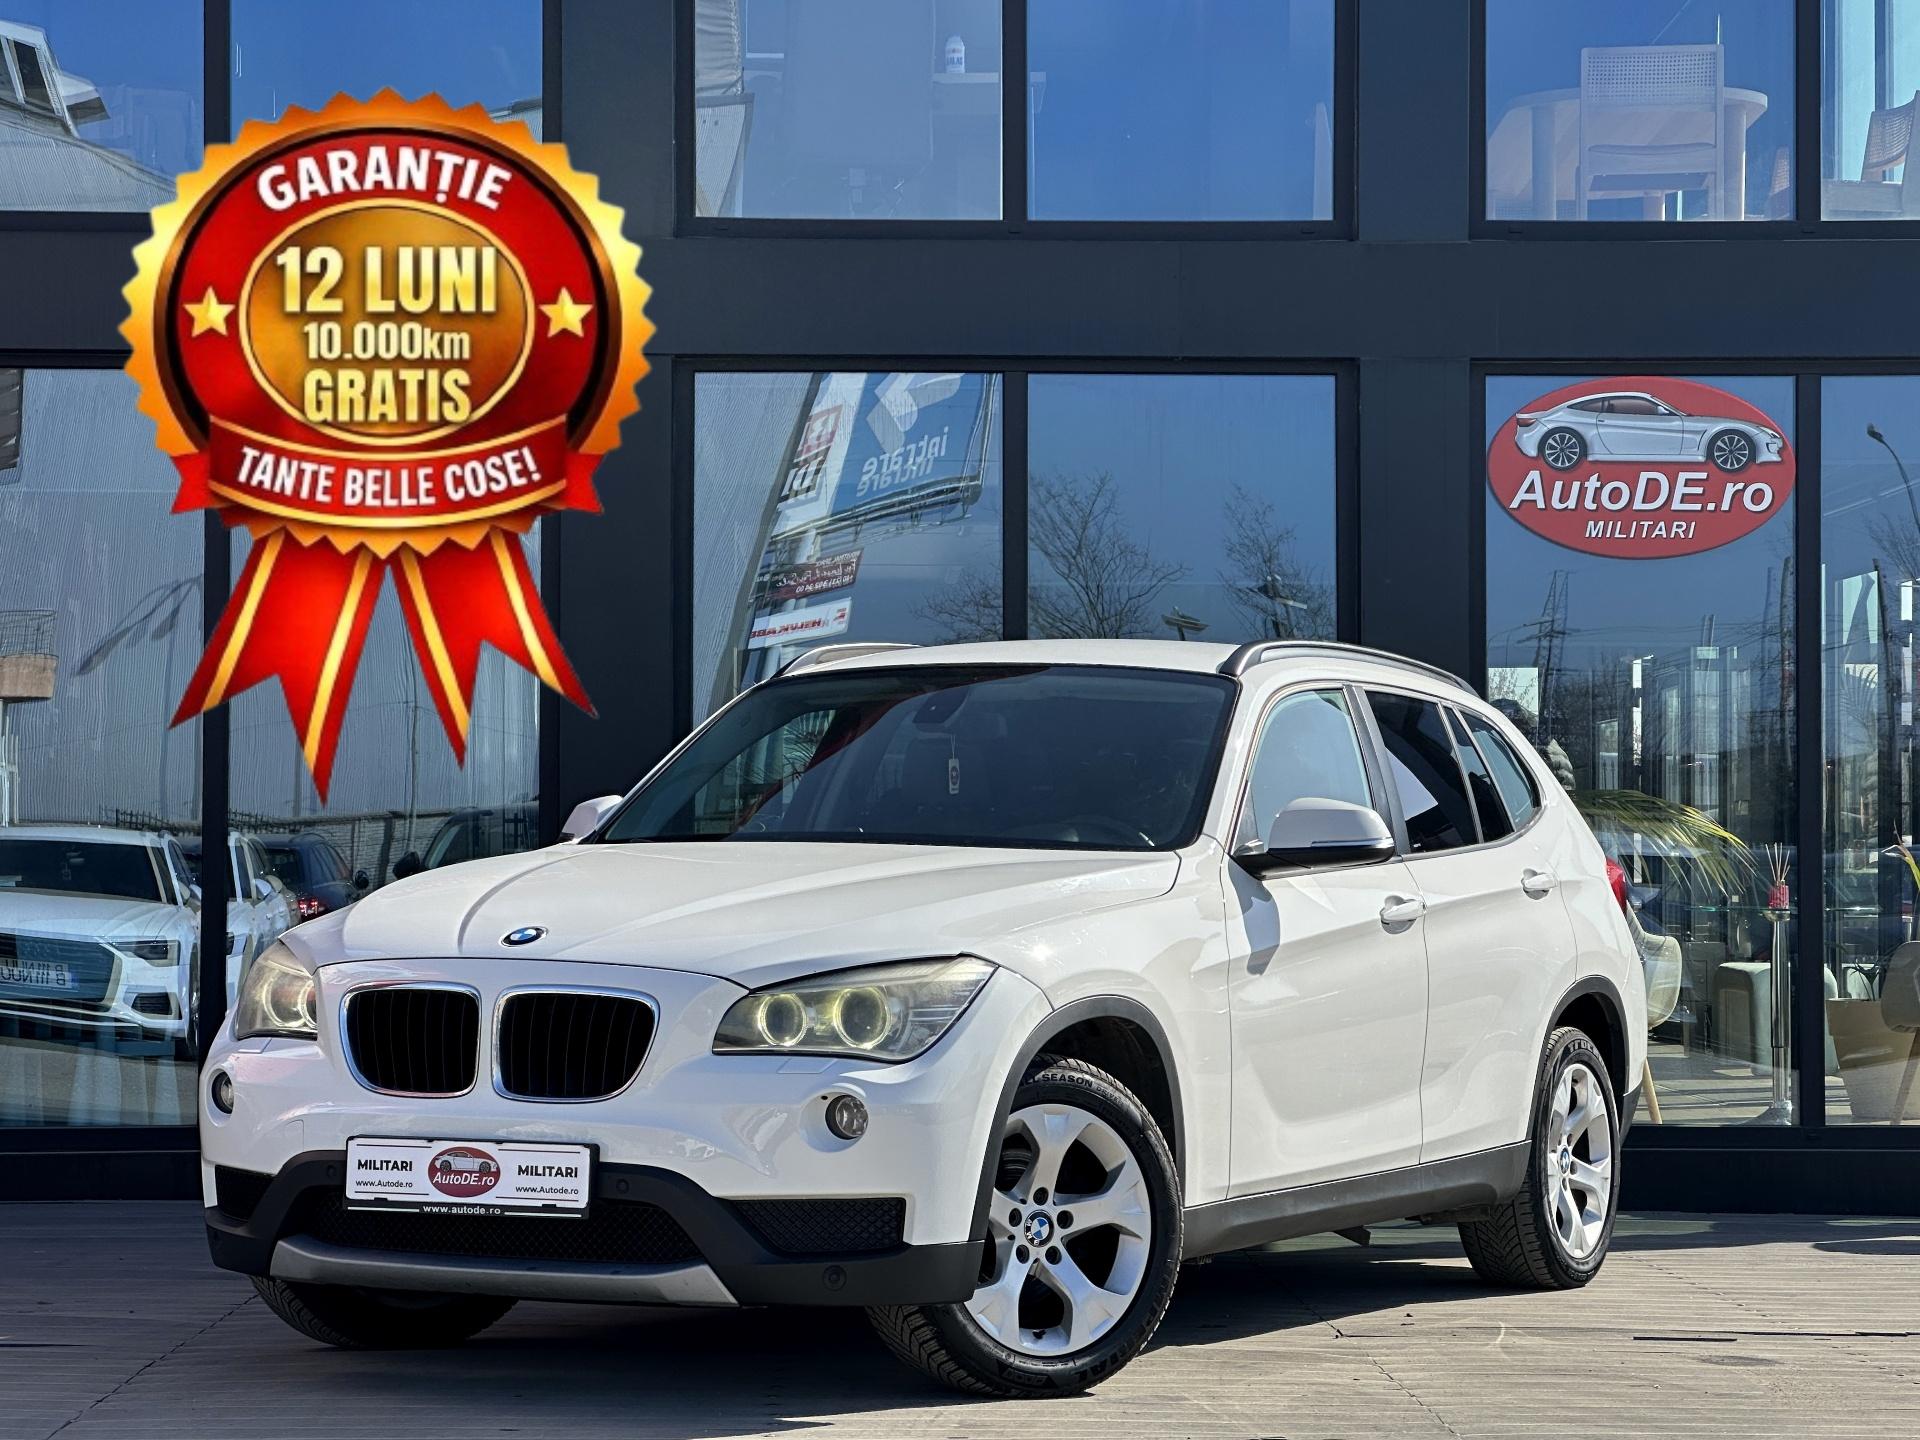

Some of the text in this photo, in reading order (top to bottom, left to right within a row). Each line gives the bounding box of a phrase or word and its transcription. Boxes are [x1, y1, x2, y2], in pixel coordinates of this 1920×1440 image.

[1508, 469, 1773, 512] AutoDE.ro
[1585, 520, 1696, 539] MILITARI
[1042, 1073, 1093, 1088] SEASON
[357, 1159, 413, 1172] MILITARI
[517, 1164, 579, 1178] MILITARI
[355, 1179, 413, 1189] www.Autode.ro
[432, 1171, 495, 1186] AutoDE.ro
[515, 1185, 579, 1195] www.Autode.ro
[422, 1205, 501, 1215] www.autode.ro
